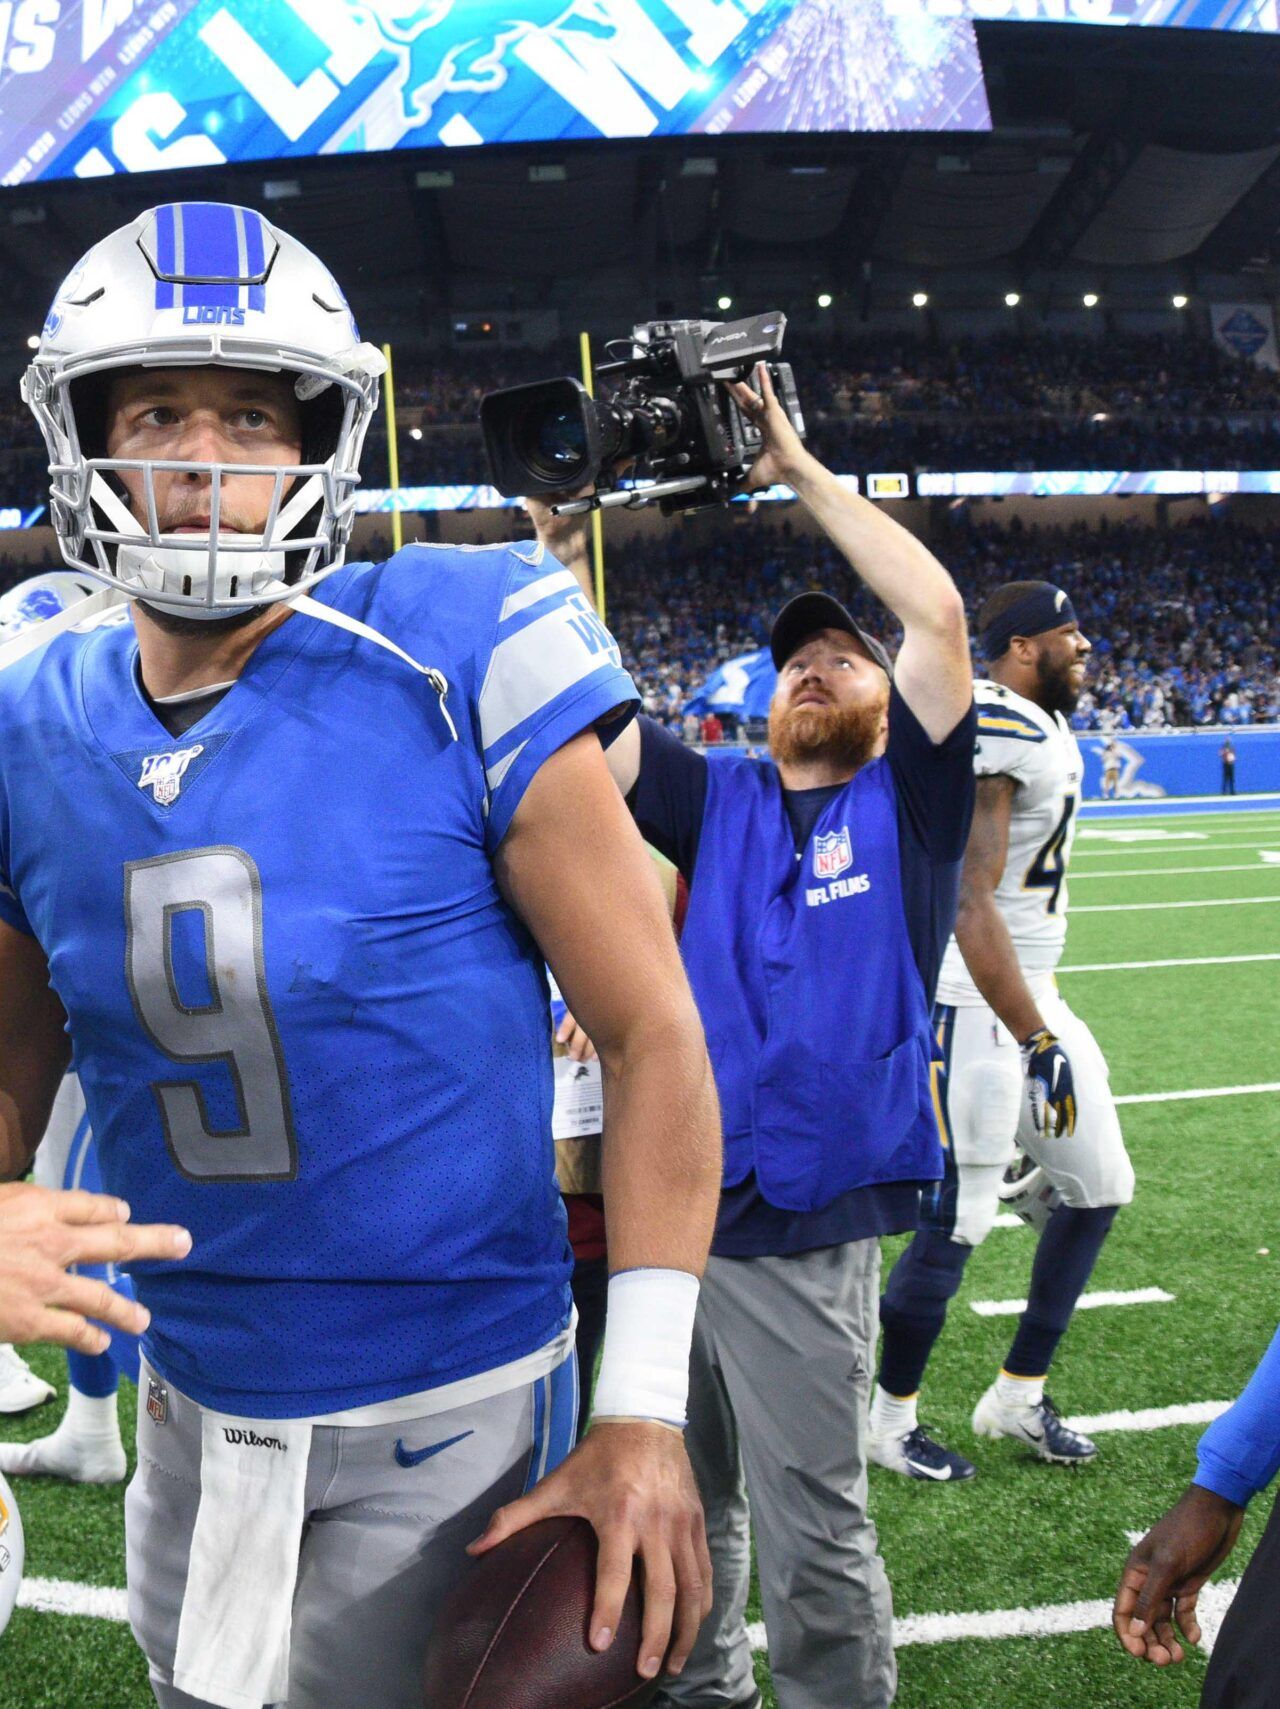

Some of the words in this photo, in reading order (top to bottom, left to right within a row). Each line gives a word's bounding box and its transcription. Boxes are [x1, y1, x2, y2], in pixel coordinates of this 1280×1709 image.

[56, 90, 94, 131] LIONS
[116, 25, 155, 66] LIONS
[818, 846, 848, 873] NFL
[829, 873, 871, 900] FILMS
[124, 844, 298, 1184] 9
[222, 1427, 283, 1450] Wilson
